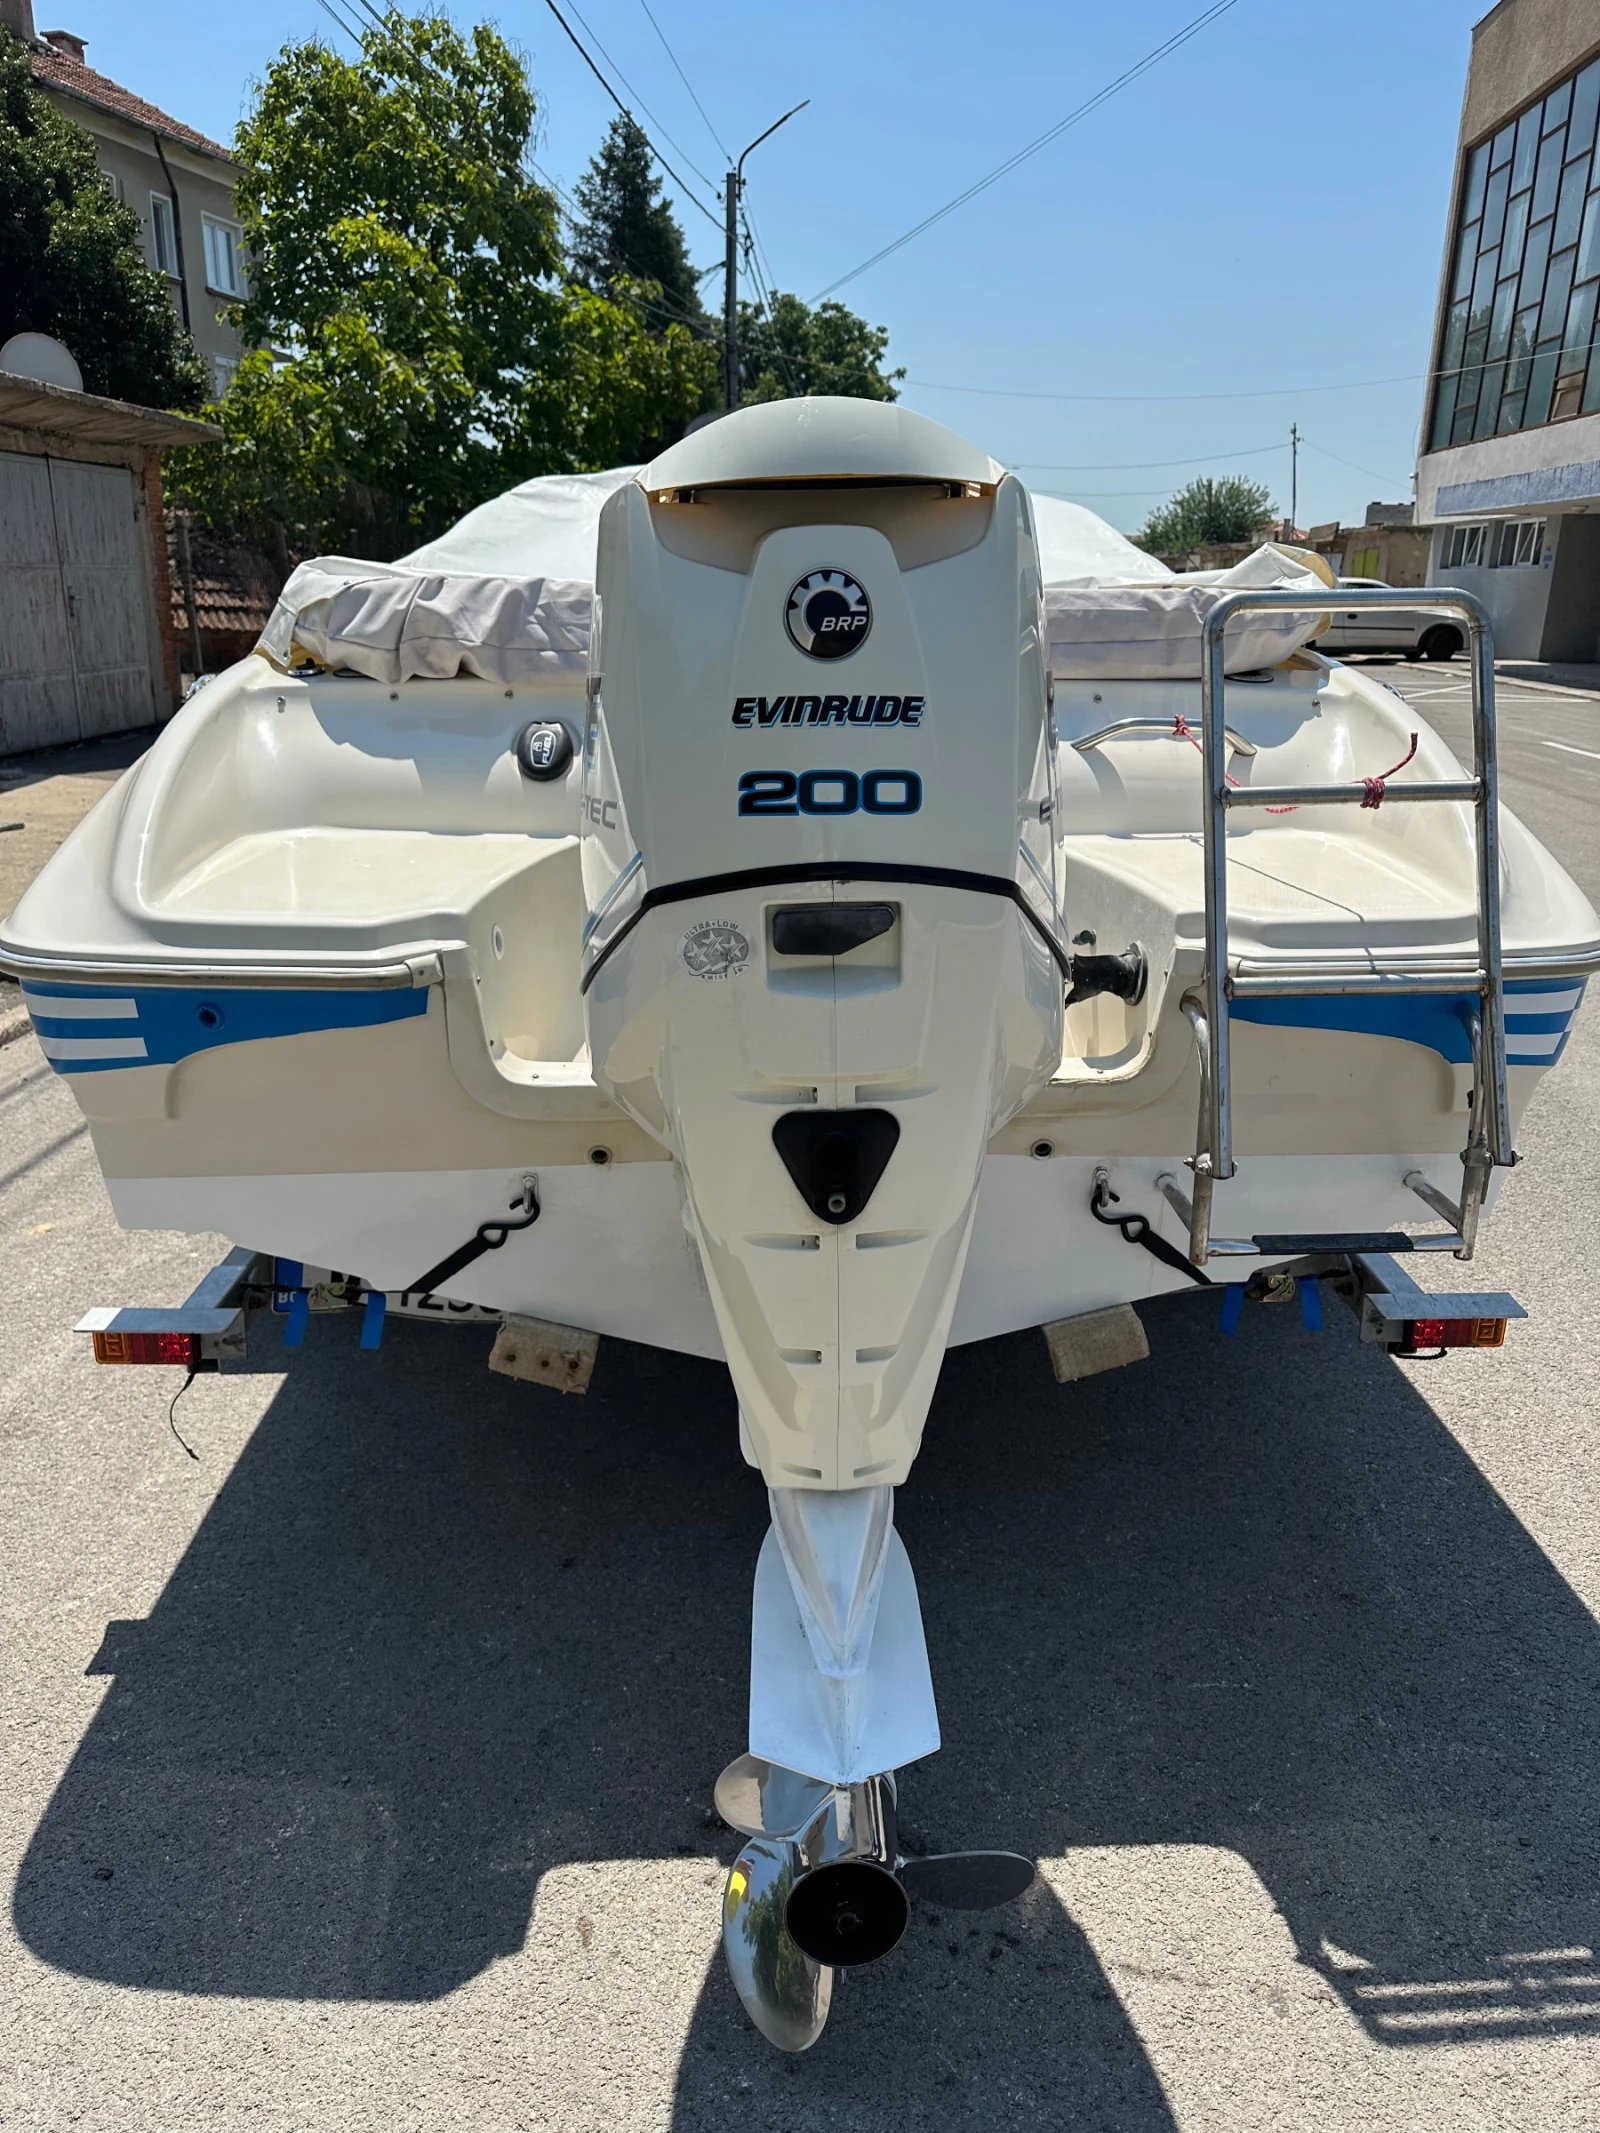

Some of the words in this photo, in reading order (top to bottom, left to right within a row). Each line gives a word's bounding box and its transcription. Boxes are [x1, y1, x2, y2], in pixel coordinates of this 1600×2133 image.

[820, 616, 867, 632] BRP
[732, 695, 926, 728] EVINRUDE
[541, 735, 553, 765] FUEL
[738, 769, 922, 817] 200
